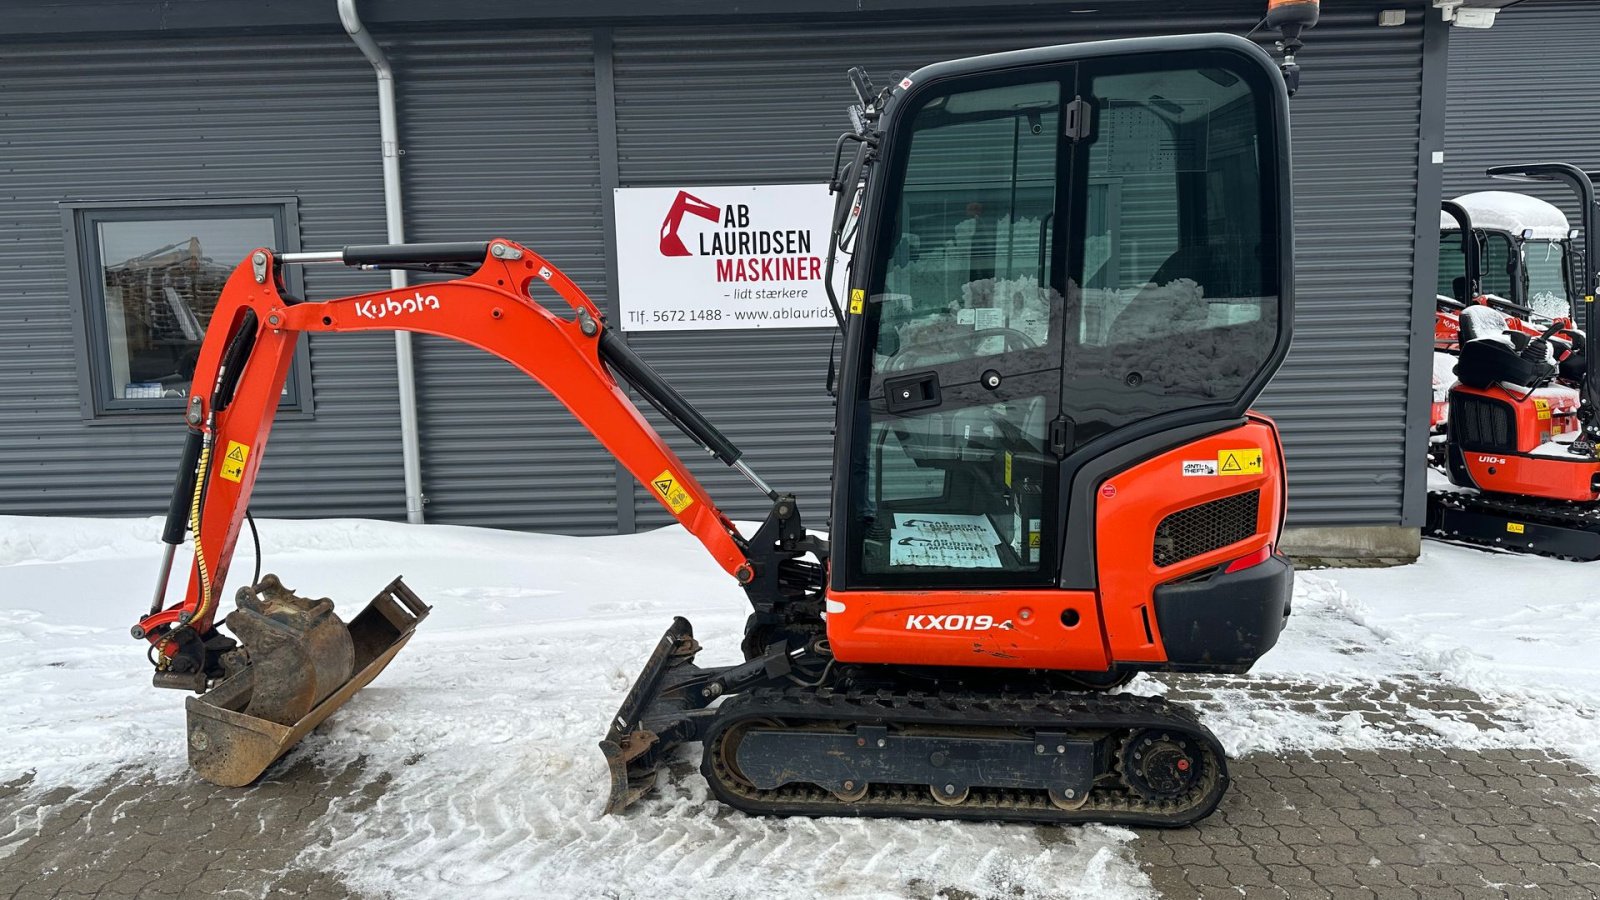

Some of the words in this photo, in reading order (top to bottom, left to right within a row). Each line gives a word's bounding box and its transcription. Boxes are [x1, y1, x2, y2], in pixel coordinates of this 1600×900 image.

[724, 204, 750, 229] AB
[699, 230, 811, 256] LAURIDSEN
[716, 256, 822, 282] MASKINER
[354, 292, 440, 319] Kubota
[733, 288, 752, 300] lidt
[755, 288, 809, 299] stærkere
[628, 310, 649, 325] Tlf.
[653, 310, 686, 322] 5672
[689, 309, 722, 321] 1488
[734, 306, 835, 321] www.ablaurids
[906, 614, 1013, 631] KX019-4
